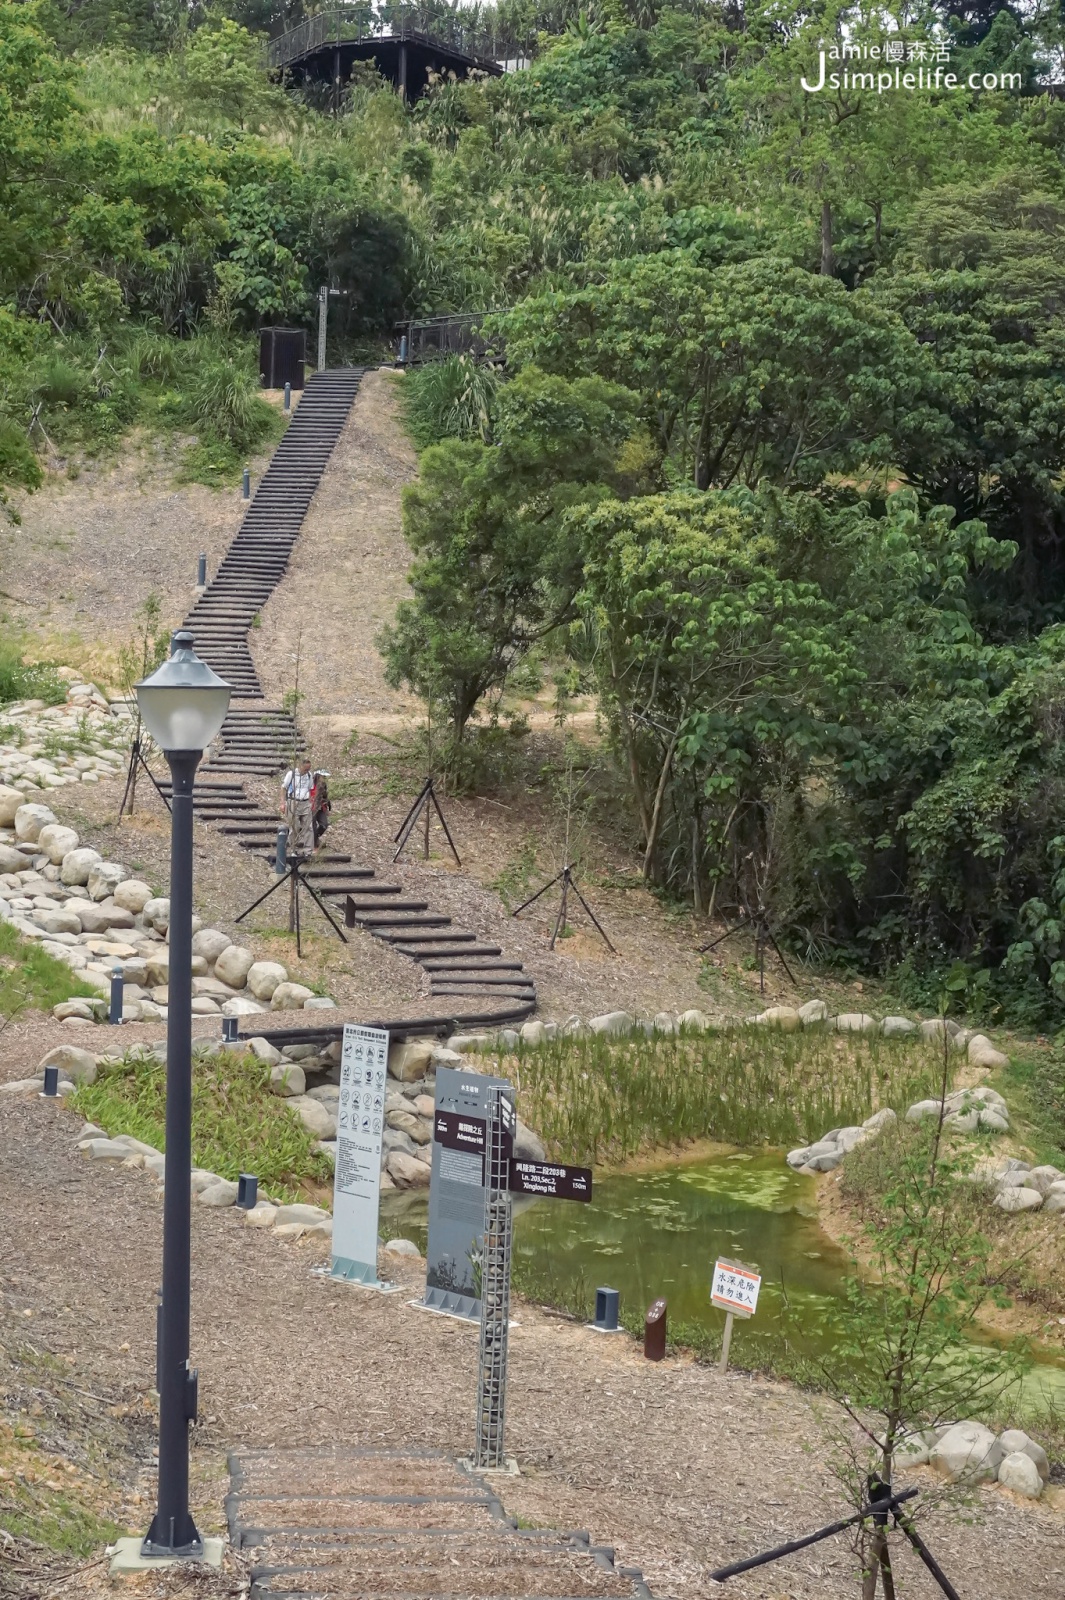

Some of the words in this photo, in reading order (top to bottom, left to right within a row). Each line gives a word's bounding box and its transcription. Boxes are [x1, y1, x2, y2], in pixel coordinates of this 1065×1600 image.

[516, 1162, 567, 1178] 興隆路二段203巷
[521, 1173, 530, 1181] Ln.
[523, 1182, 548, 1193] Xinglong
[547, 1185, 557, 1193] Rd.
[572, 1182, 587, 1190] 150m
[719, 1272, 756, 1292] 水深危險
[716, 1284, 753, 1304] 請勿進入
